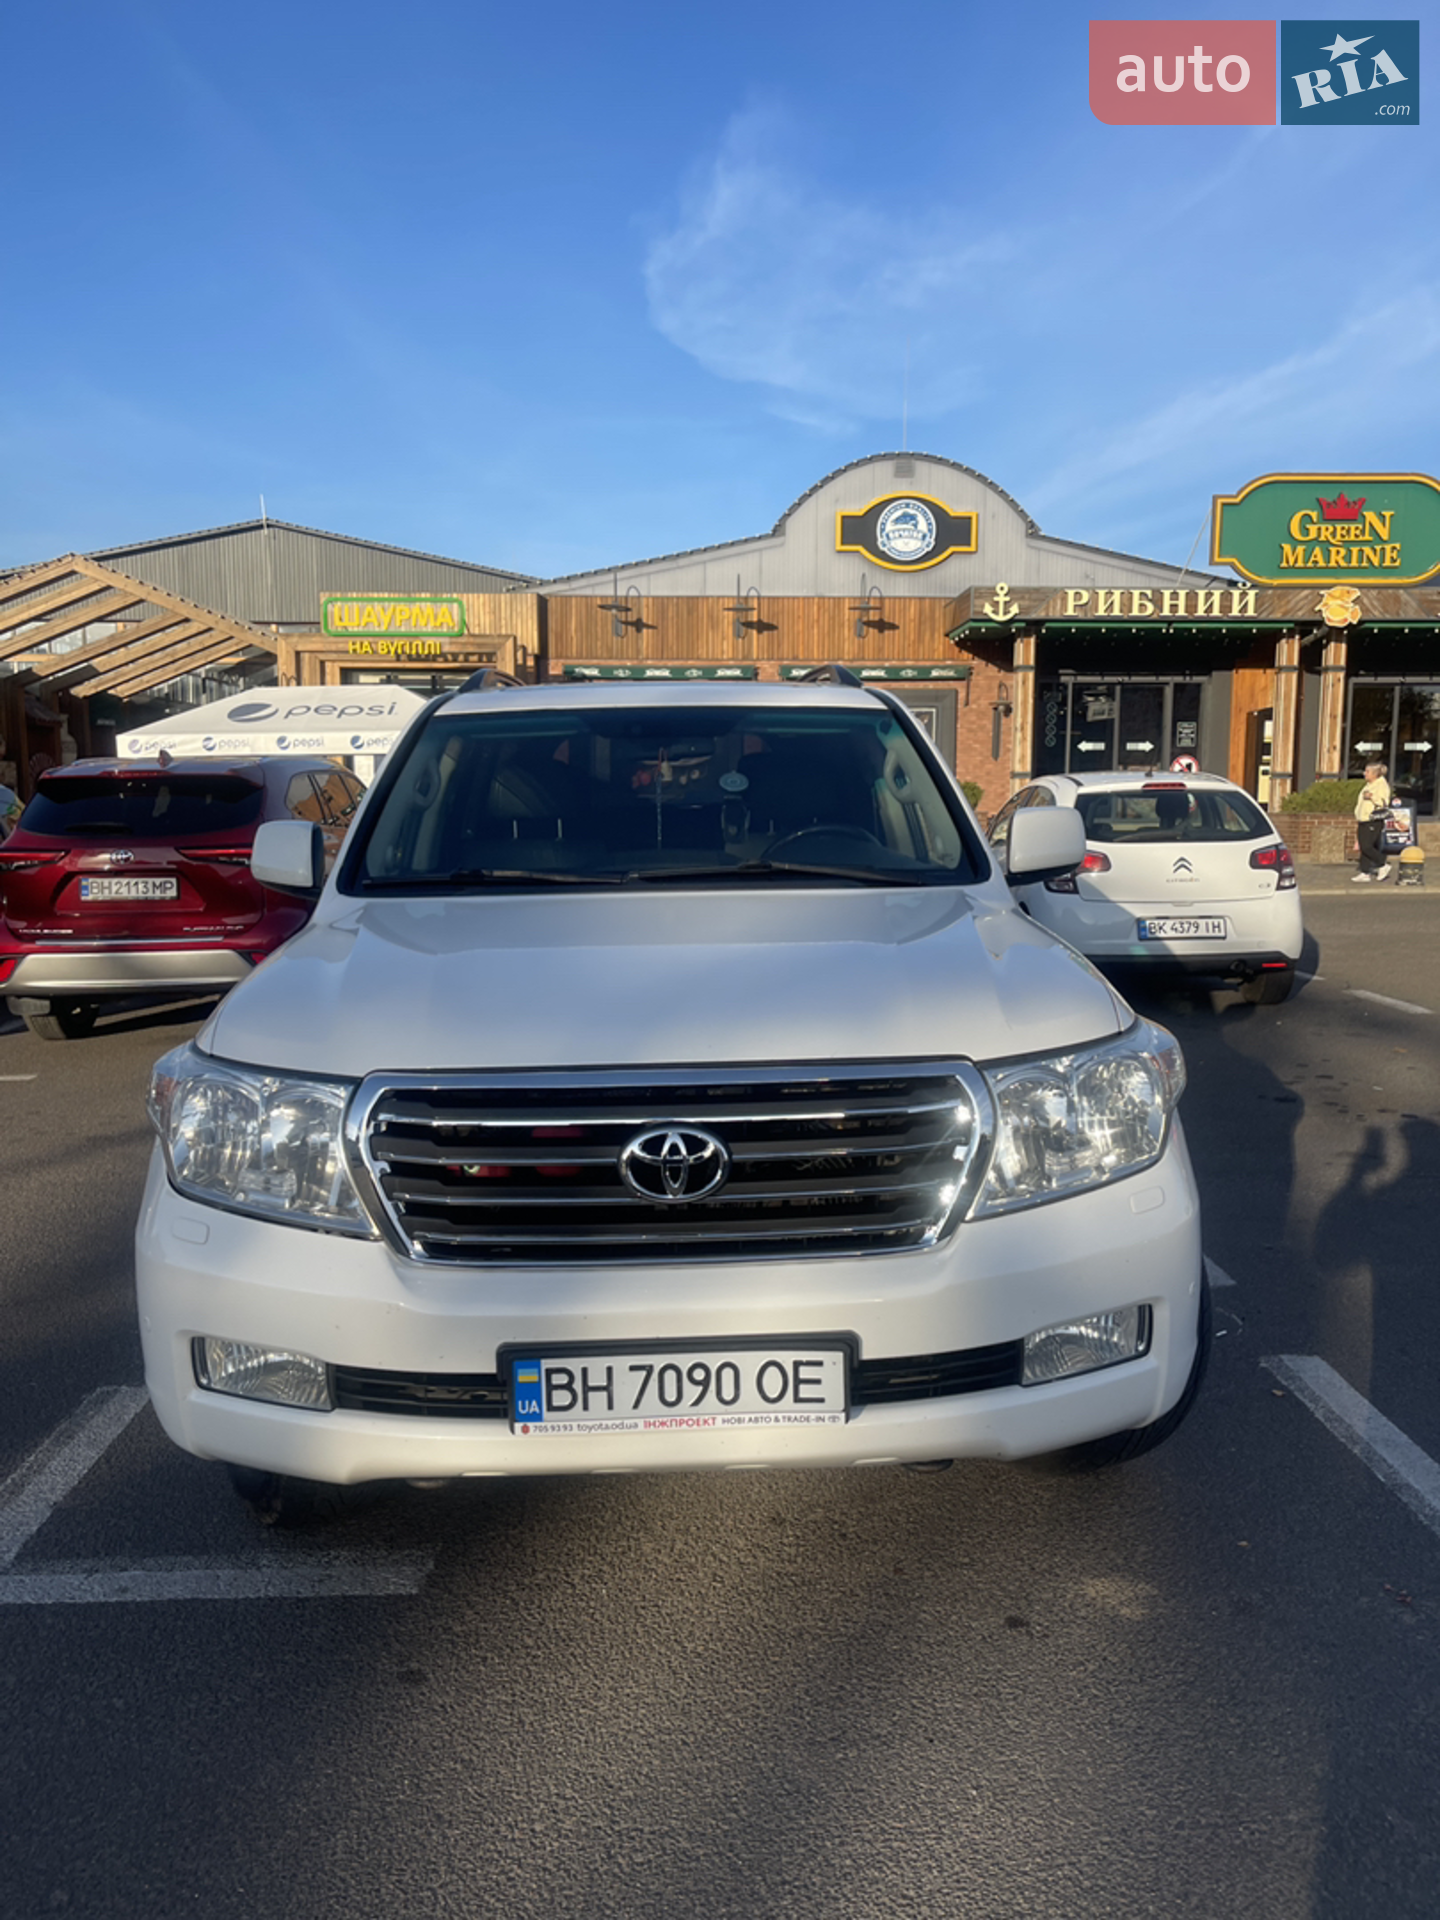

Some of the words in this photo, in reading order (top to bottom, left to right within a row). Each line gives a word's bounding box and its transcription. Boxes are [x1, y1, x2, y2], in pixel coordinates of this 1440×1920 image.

[1279, 543, 1401, 569] MARINE
[1063, 582, 1260, 616] РИБНИЙ
[334, 603, 455, 630] ШАУРМА
[348, 640, 373, 655] НА
[284, 702, 398, 719] pepsi
[218, 738, 250, 750] pepsi
[292, 737, 325, 749] pepsi
[90, 881, 112, 895] BH
[114, 881, 149, 895] 2113
[152, 881, 175, 895] MP
[1148, 921, 1167, 935] BK
[1170, 920, 1200, 934] 4379
[1205, 920, 1222, 934] IH
[545, 1365, 614, 1413] BH
[628, 1361, 741, 1410] 7090
[755, 1359, 826, 1405] OE
[518, 1400, 540, 1415] UA
